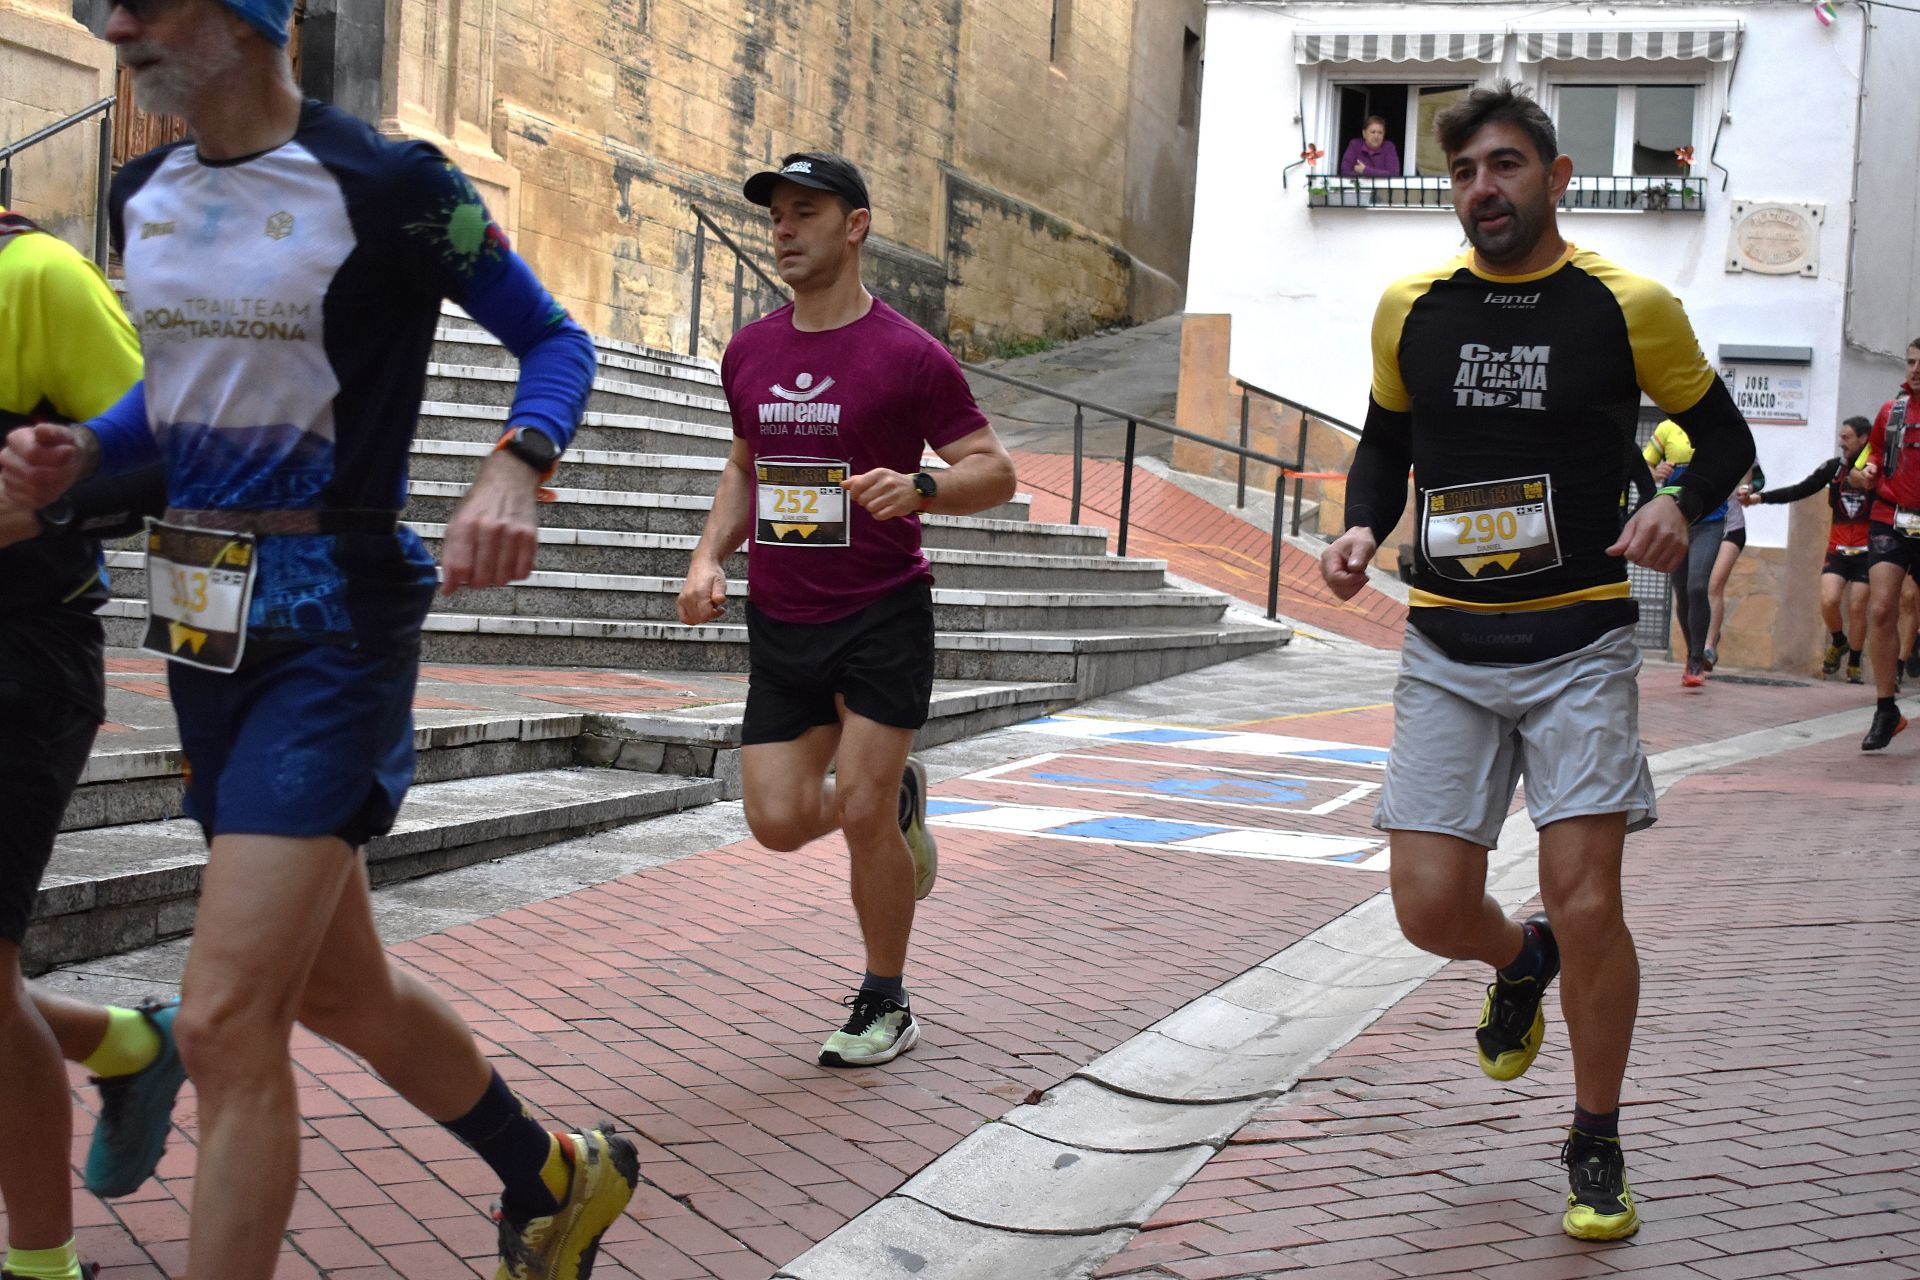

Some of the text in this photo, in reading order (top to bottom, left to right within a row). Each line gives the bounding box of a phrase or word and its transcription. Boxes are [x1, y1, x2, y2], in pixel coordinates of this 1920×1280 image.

[1483, 292, 1541, 304] land
[186, 319, 306, 342] TARAZONA
[1452, 388, 1547, 411] TRAIL
[1737, 392, 1776, 409] IGNACIO
[760, 425, 839, 437] RIOJA ALAVESA
[774, 488, 819, 514] 252
[1455, 511, 1518, 545] 290
[1476, 543, 1503, 552] DANIEL
